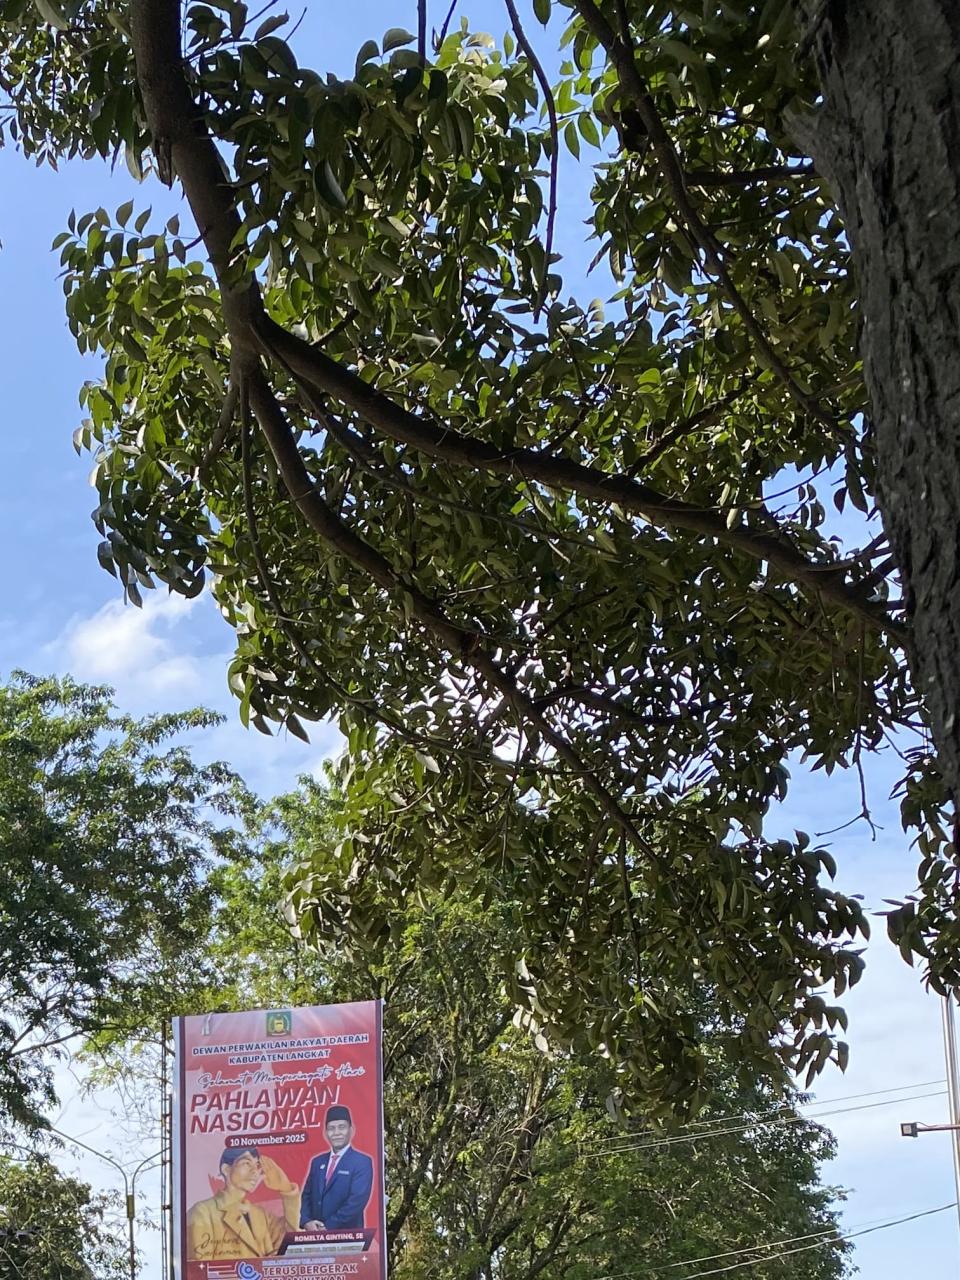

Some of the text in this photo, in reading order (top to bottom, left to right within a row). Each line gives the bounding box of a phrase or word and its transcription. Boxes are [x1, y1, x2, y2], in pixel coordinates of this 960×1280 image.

[192, 1034, 368, 1056] DEWAN PERWAKILAN RAKYAT DAERAH
[229, 1049, 330, 1065] KABUPATEN LANGKAT
[198, 1071, 252, 1089] Selamat
[335, 1062, 366, 1080] Hari
[190, 1085, 341, 1113] PAHLAWAN
[190, 1107, 321, 1135] NASIONAL
[230, 1134, 306, 1147] 10 November 2025
[263, 1263, 358, 1276] TERUS BERGERAK
